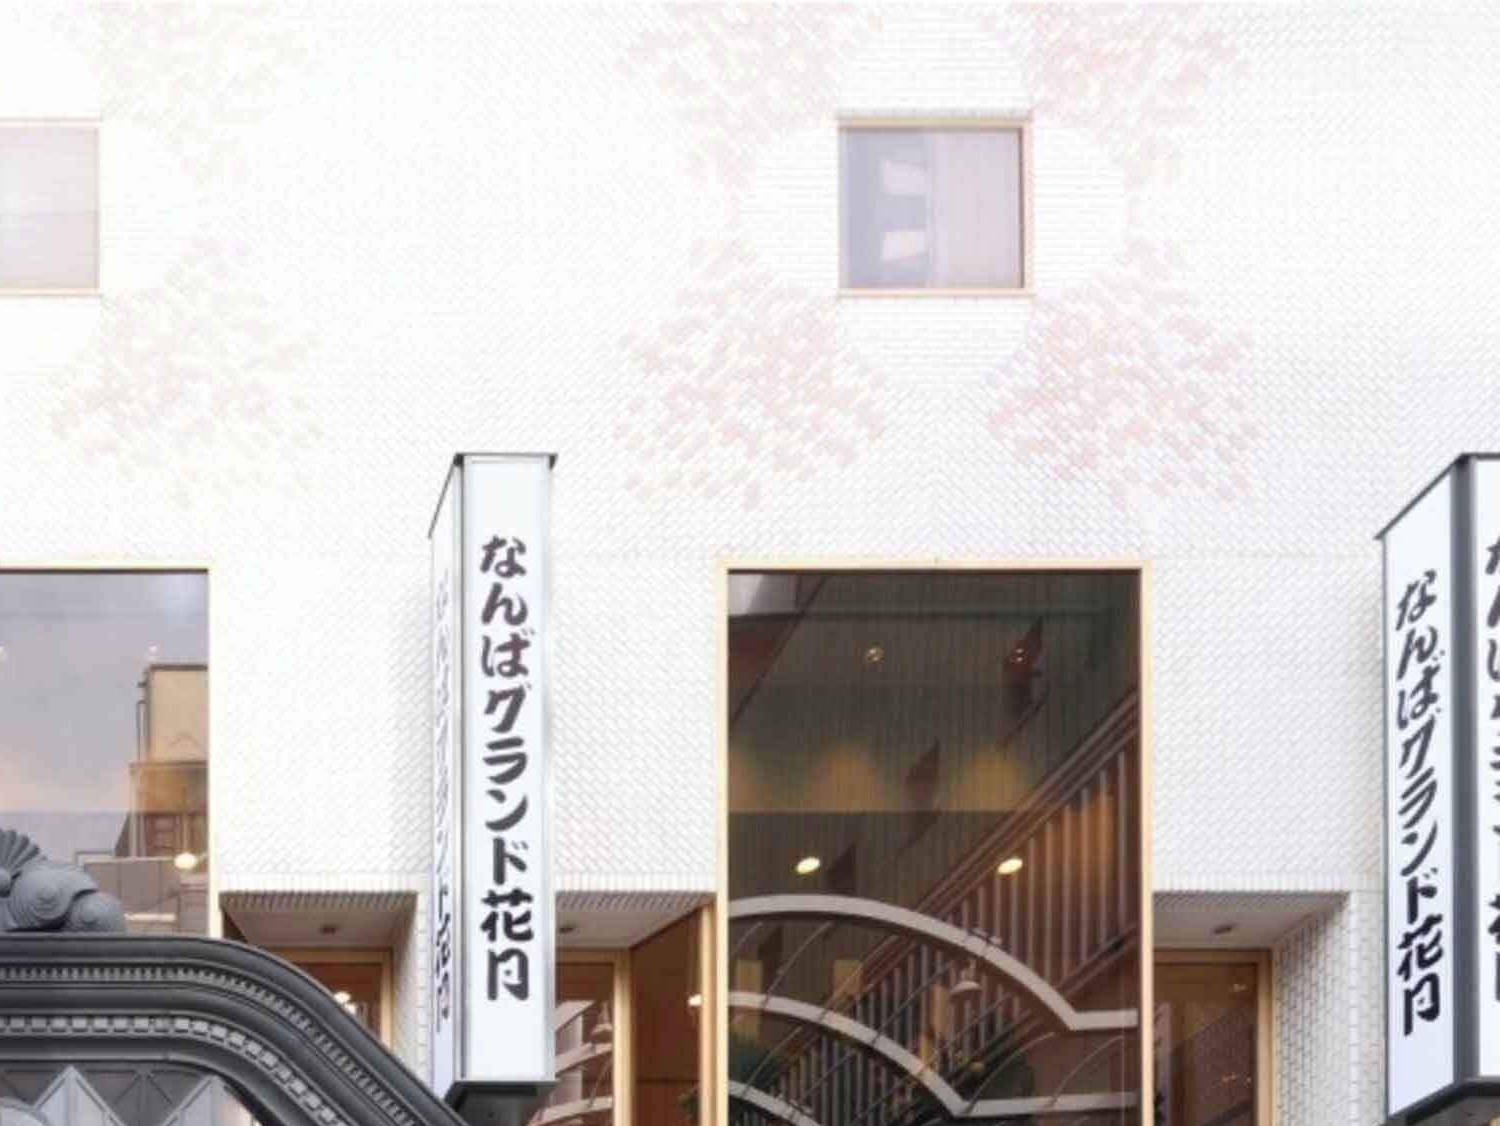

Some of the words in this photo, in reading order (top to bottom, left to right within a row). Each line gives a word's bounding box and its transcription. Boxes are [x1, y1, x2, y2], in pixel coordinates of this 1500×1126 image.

[479, 535, 535, 1001] なんばグランド花月
[1395, 570, 1445, 1037] なんばグランド花月
